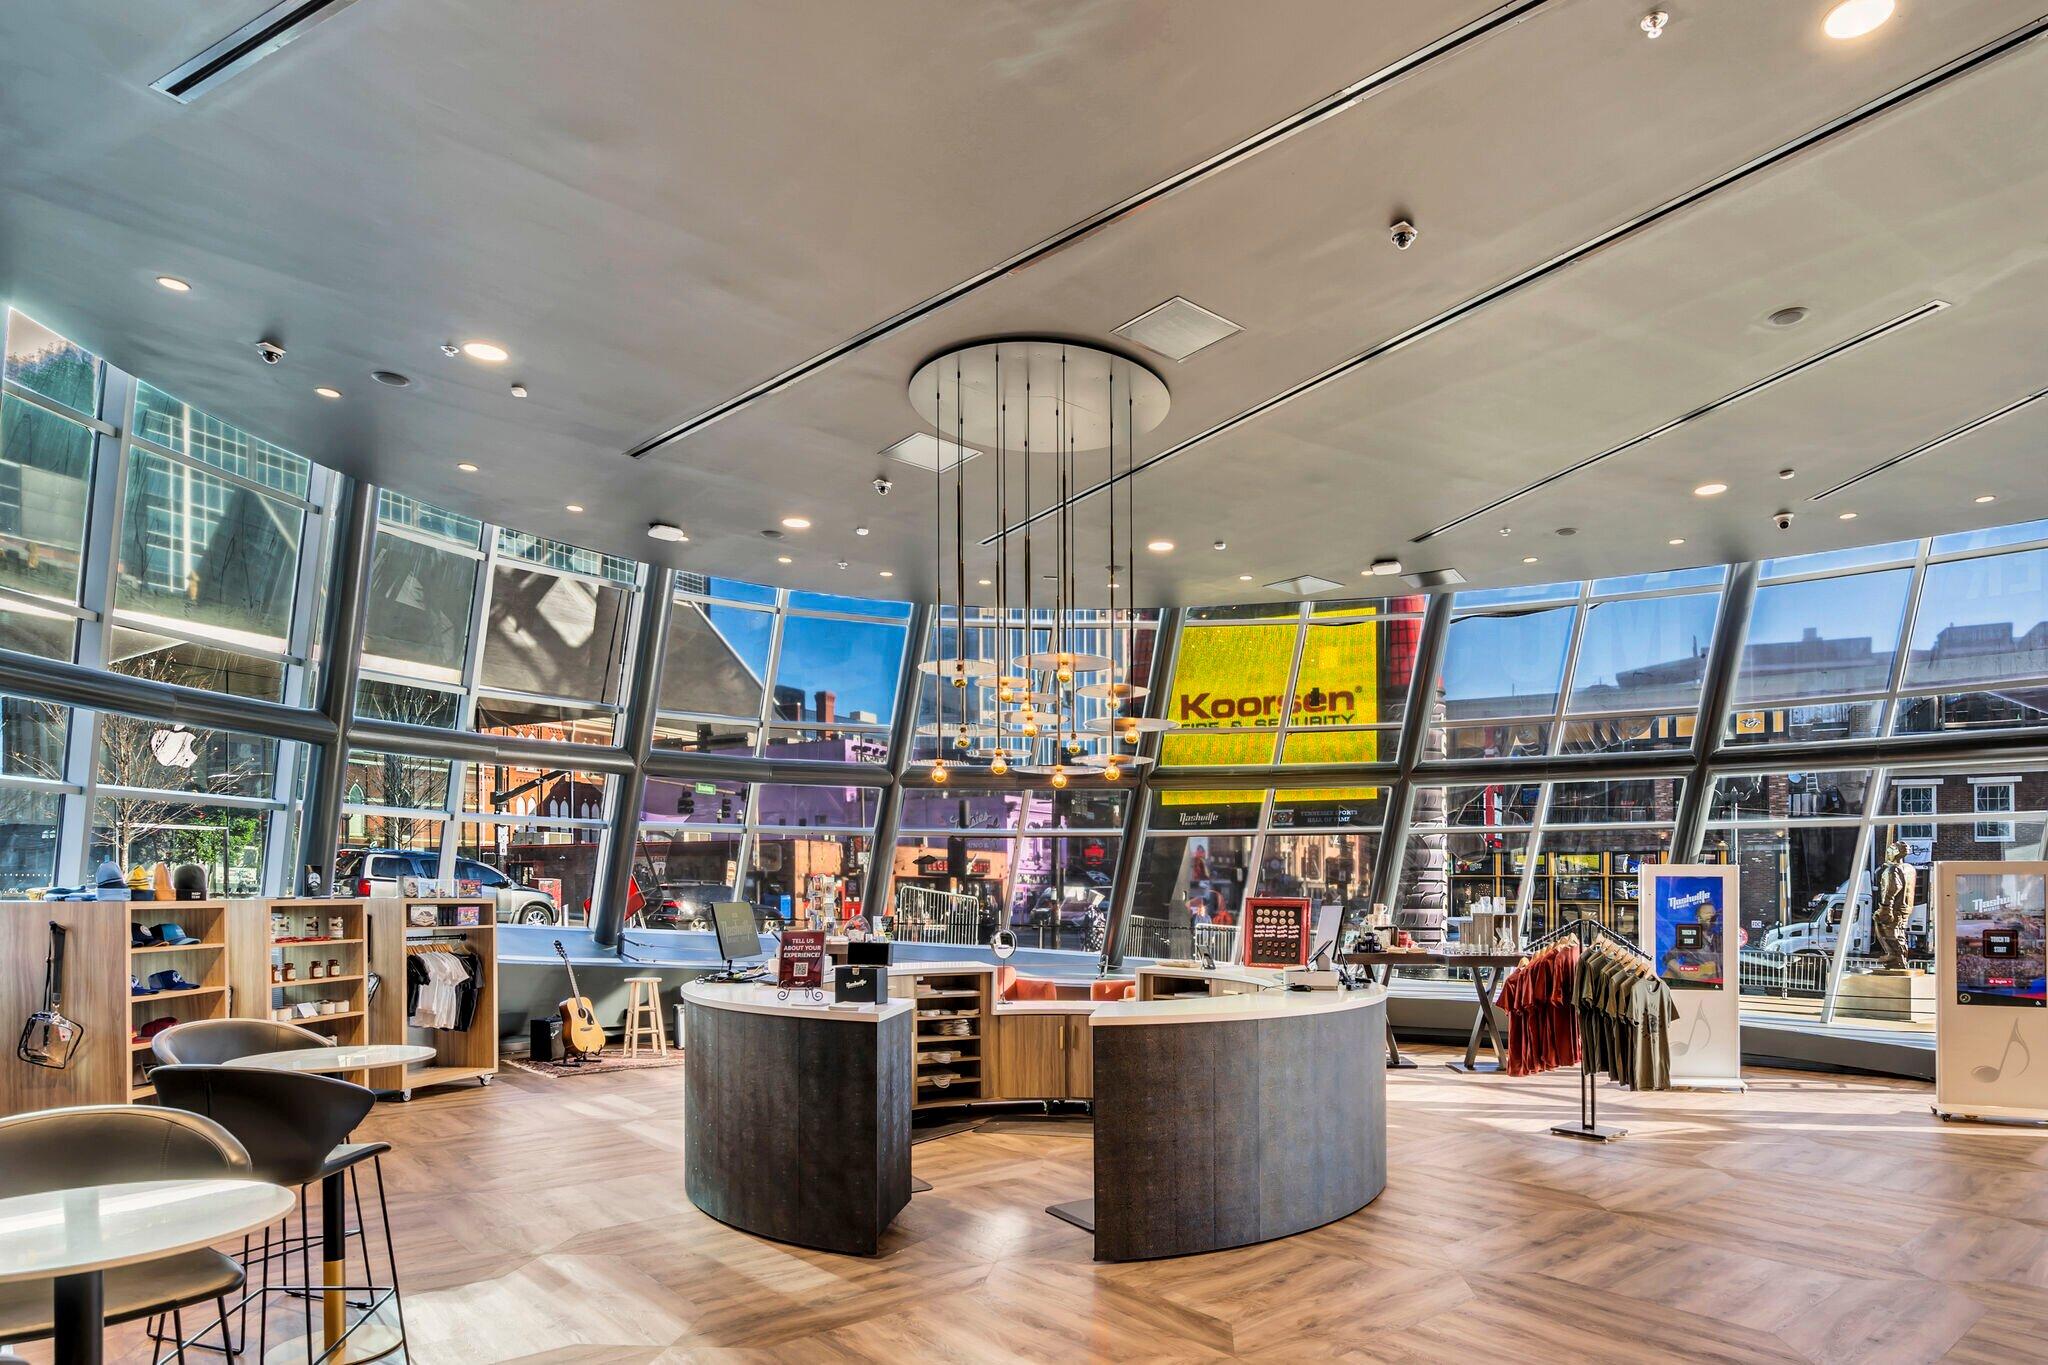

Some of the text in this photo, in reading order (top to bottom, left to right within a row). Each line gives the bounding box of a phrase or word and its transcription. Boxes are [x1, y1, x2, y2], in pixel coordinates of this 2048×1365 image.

[1181, 691, 1355, 720] Koorsen
[1179, 812, 1219, 826] Nashville
[1668, 890, 1711, 910] Nashville
